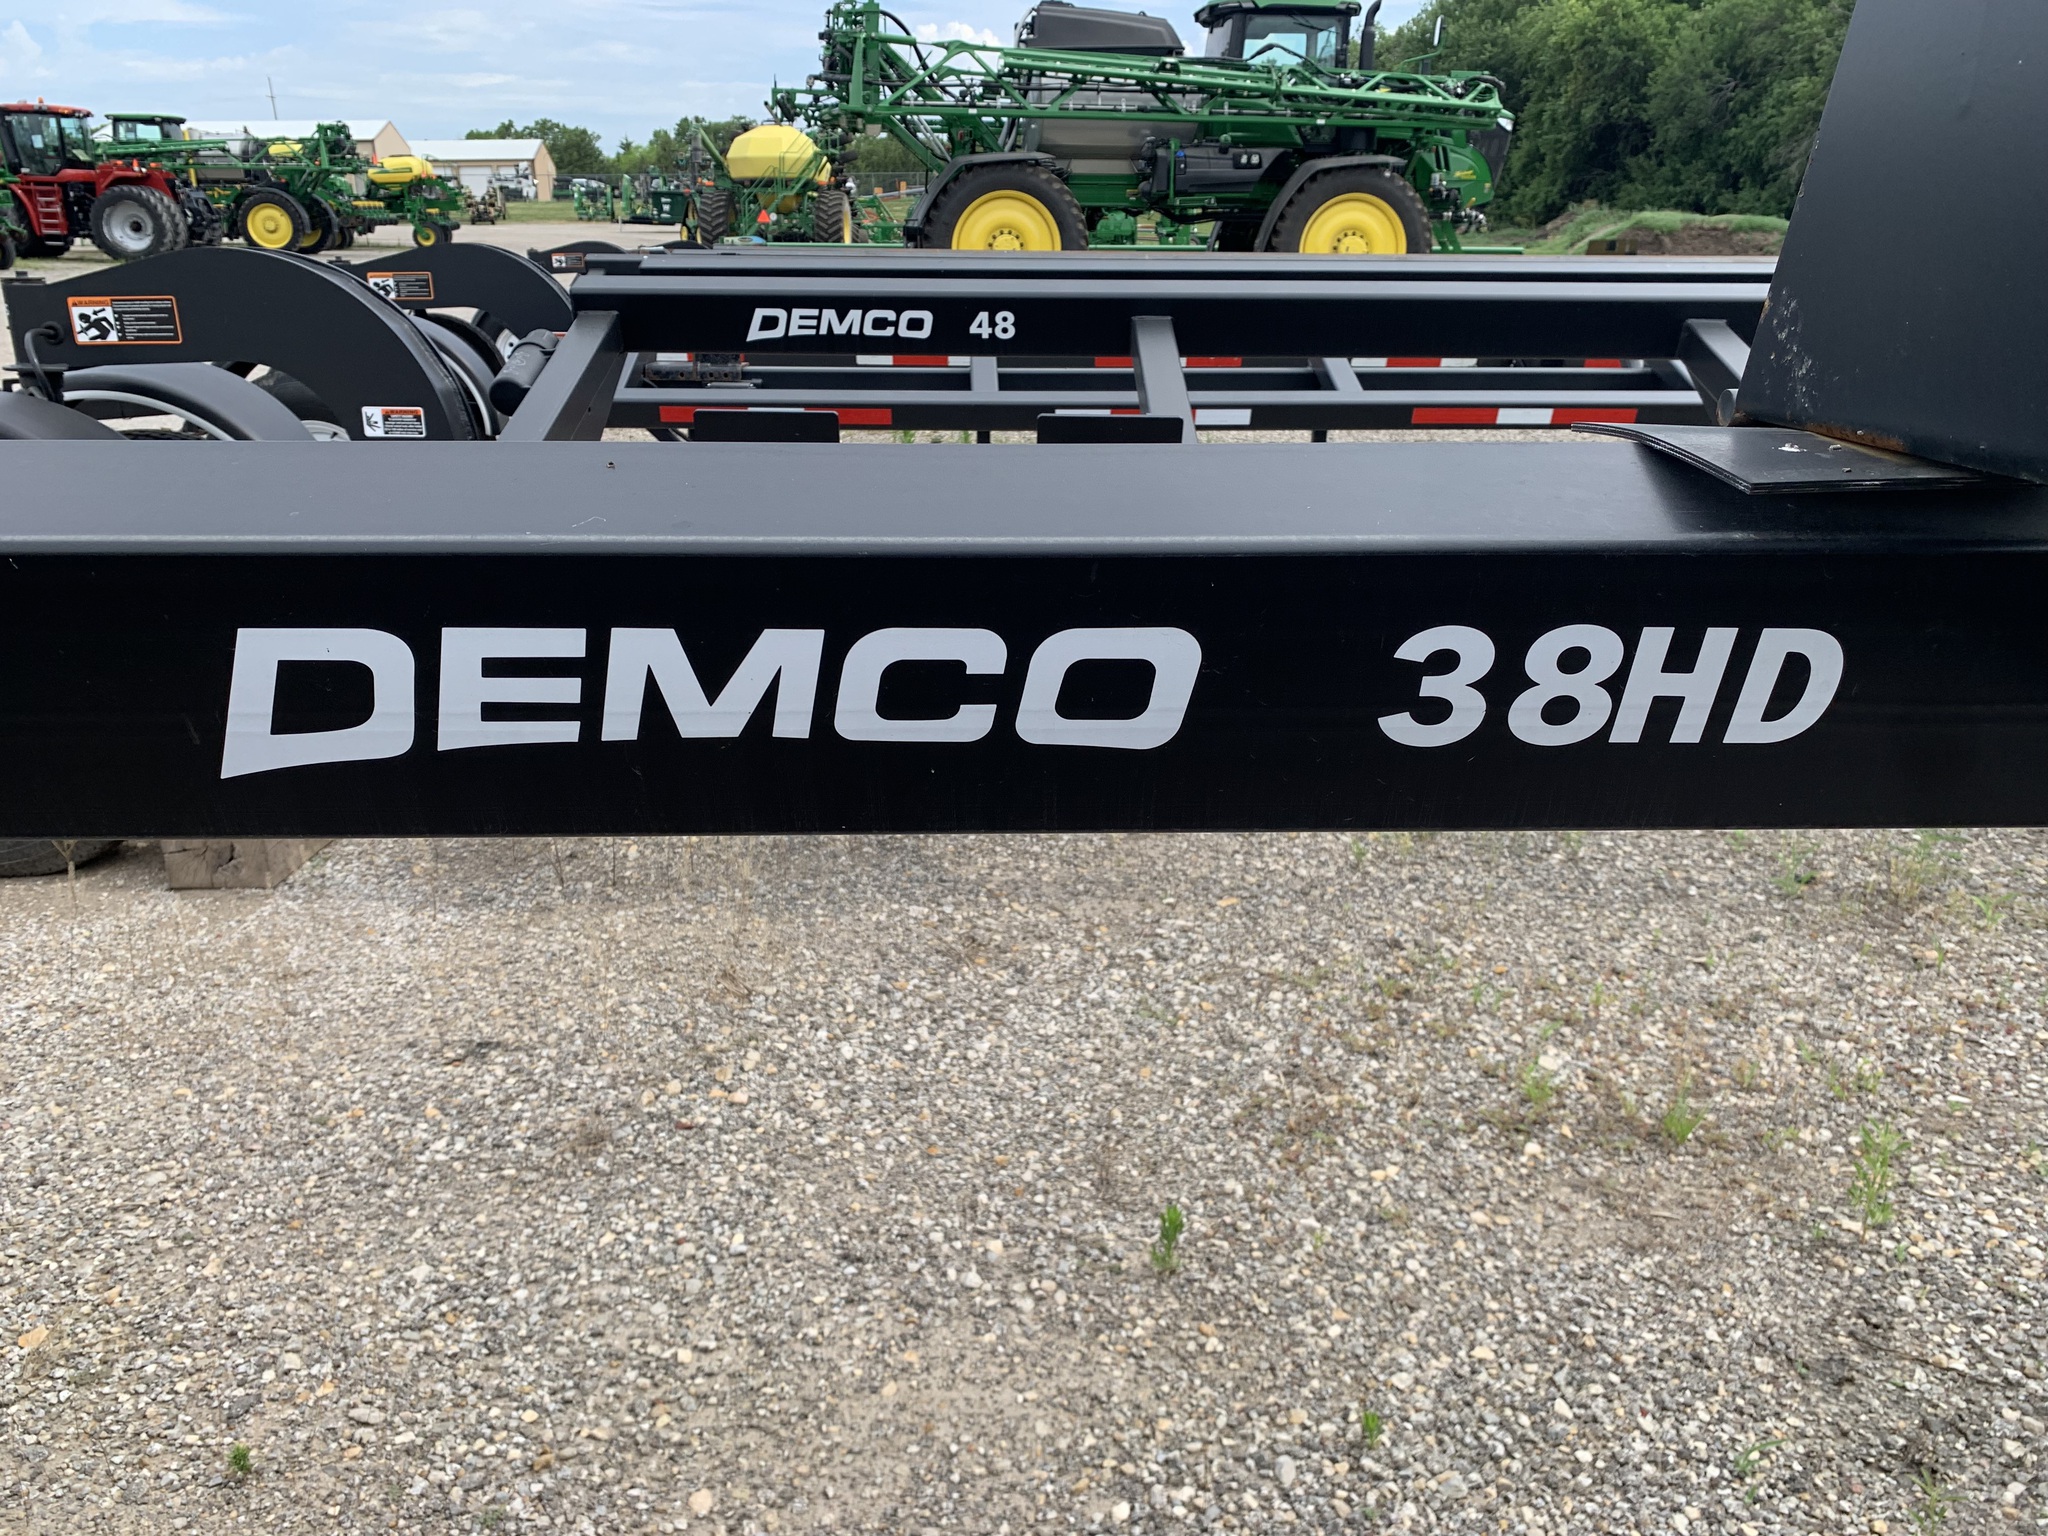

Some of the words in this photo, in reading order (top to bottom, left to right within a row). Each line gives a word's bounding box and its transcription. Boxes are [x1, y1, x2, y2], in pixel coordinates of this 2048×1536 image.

[745, 307, 934, 342] DEMCO
[969, 310, 1016, 340] 48
[220, 626, 1202, 780] DEMCO
[1377, 623, 1844, 748] 38HD
